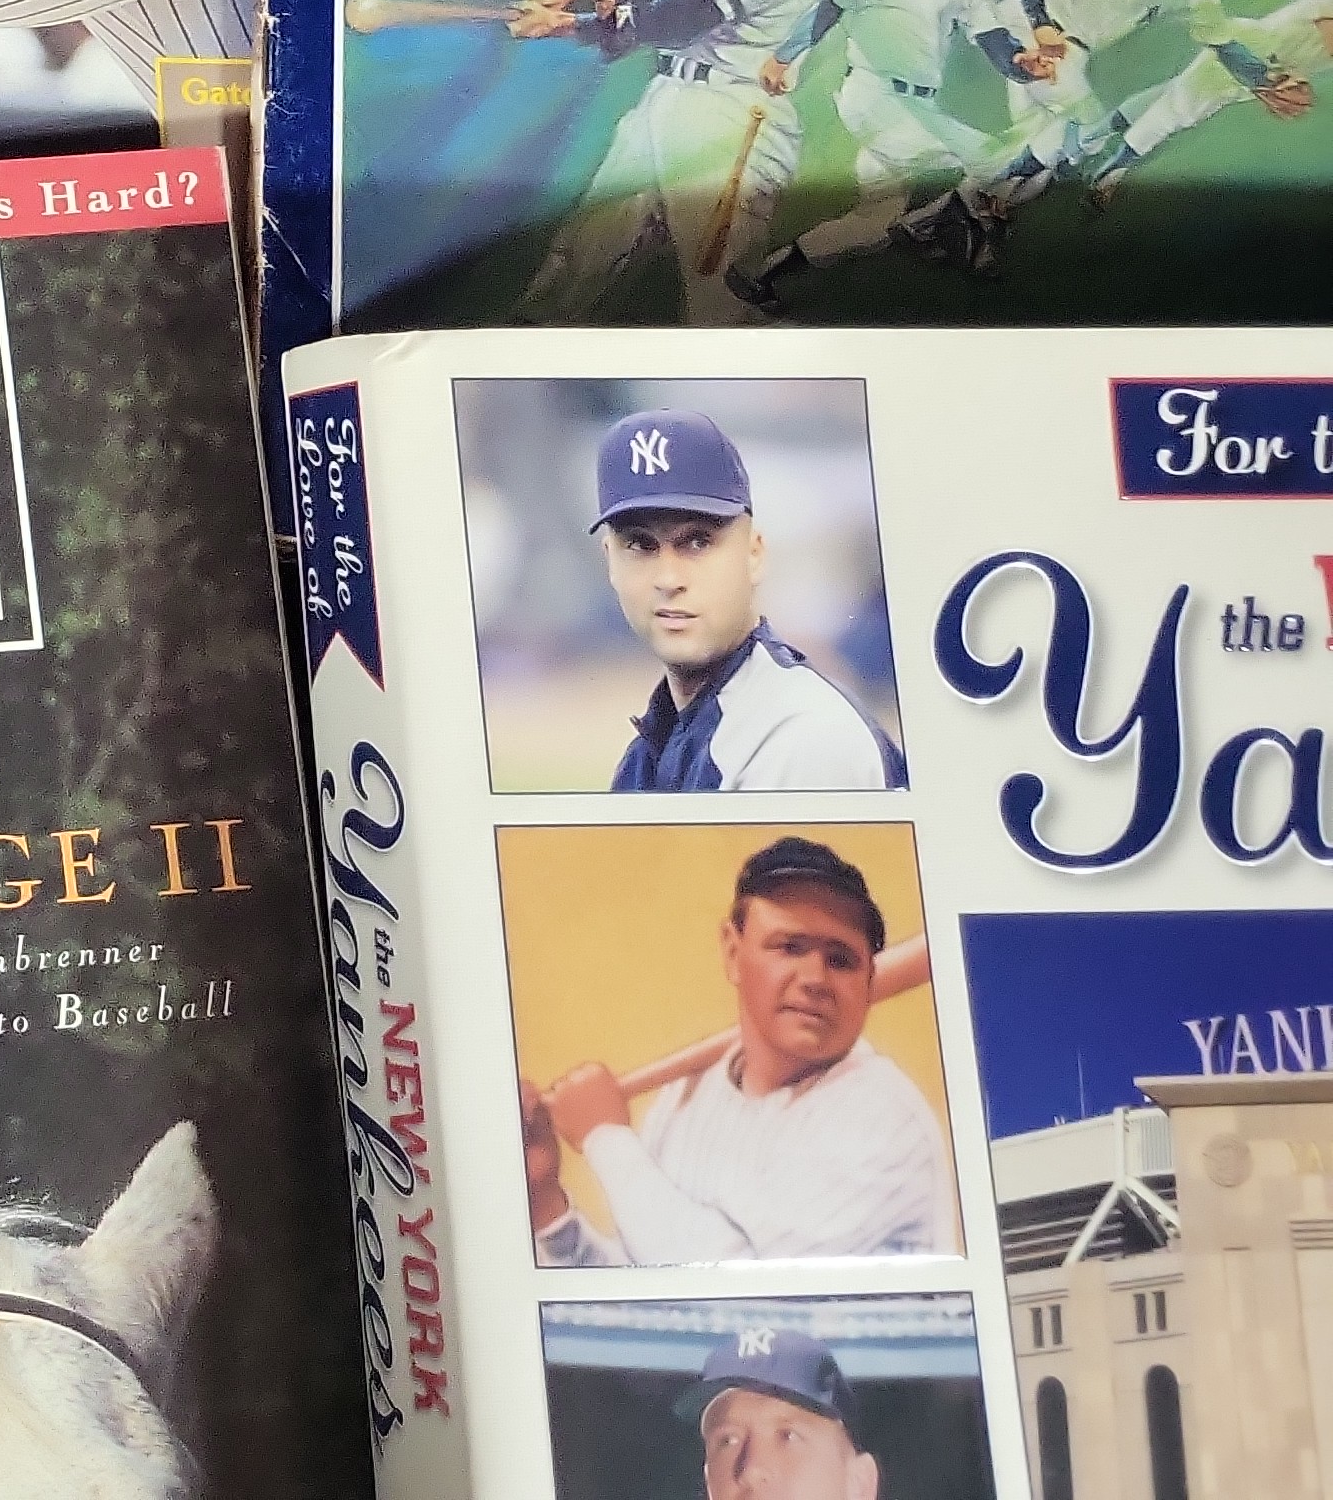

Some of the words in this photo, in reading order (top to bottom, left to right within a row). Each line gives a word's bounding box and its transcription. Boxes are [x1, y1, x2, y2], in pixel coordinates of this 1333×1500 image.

[38, 171, 201, 218] Hard?
[324, 417, 357, 521] For
[630, 428, 670, 476] NY
[1156, 388, 1294, 476] For
[296, 417, 324, 547] Love
[308, 566, 333, 620] of
[334, 533, 363, 609] the
[1221, 595, 1306, 652] the
[150, 818, 251, 898] II
[373, 926, 394, 990] the
[54, 979, 233, 1031] Baseball
[319, 739, 416, 1458] Yankees
[380, 999, 434, 1187] NEW
[396, 1207, 450, 1417] YORK
